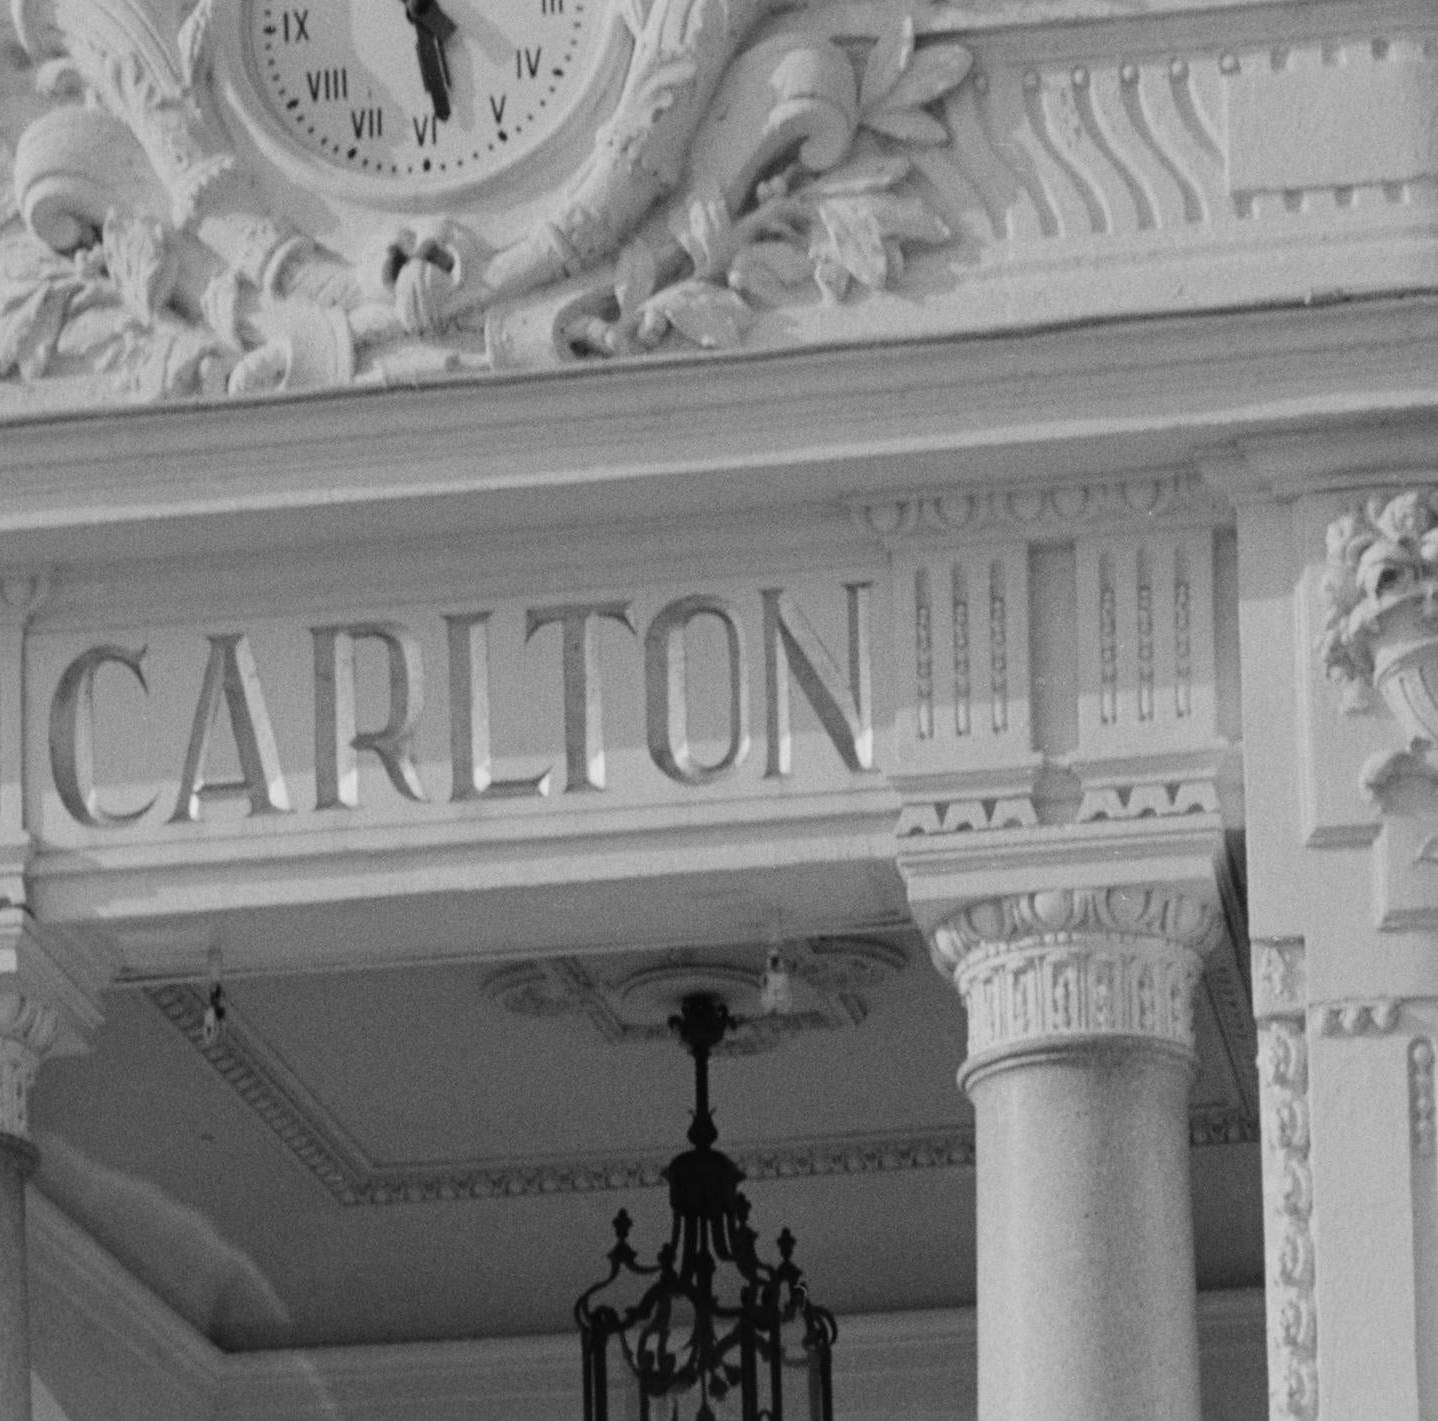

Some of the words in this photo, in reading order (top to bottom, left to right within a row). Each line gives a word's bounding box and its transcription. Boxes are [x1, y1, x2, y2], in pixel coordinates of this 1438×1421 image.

[283, 9, 309, 43] IX
[516, 46, 541, 79] IV
[306, 67, 347, 102] VIII
[351, 106, 382, 140] VII
[489, 94, 506, 125] V
[413, 114, 437, 147] VI
[47, 580, 881, 828] CARLTON
